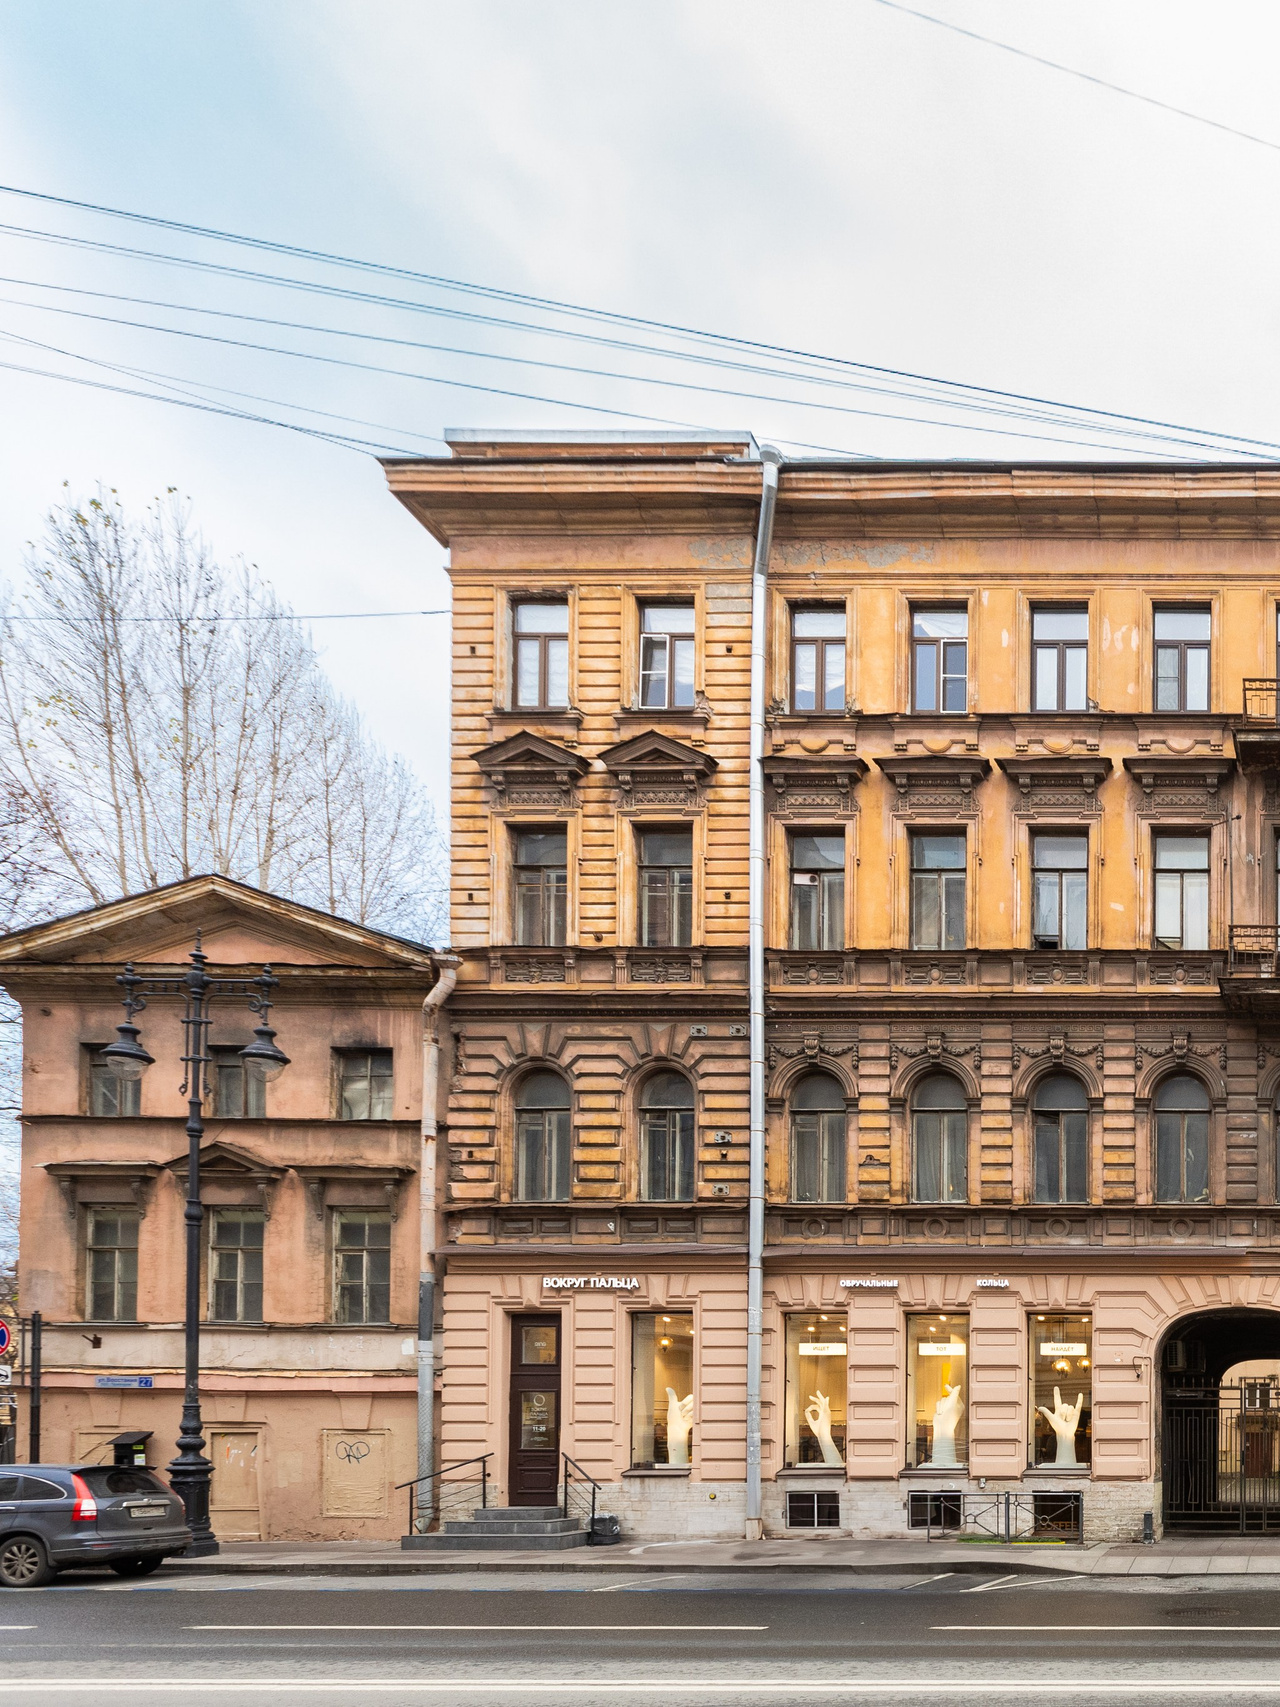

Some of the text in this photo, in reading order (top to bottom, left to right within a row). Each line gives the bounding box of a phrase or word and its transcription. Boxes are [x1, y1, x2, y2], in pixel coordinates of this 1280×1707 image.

[543, 1278, 639, 1289] ВОКРУГ ПАЛЬЦА
[976, 1279, 1009, 1288] КОЛЬЦА
[140, 1378, 152, 1387] 27
